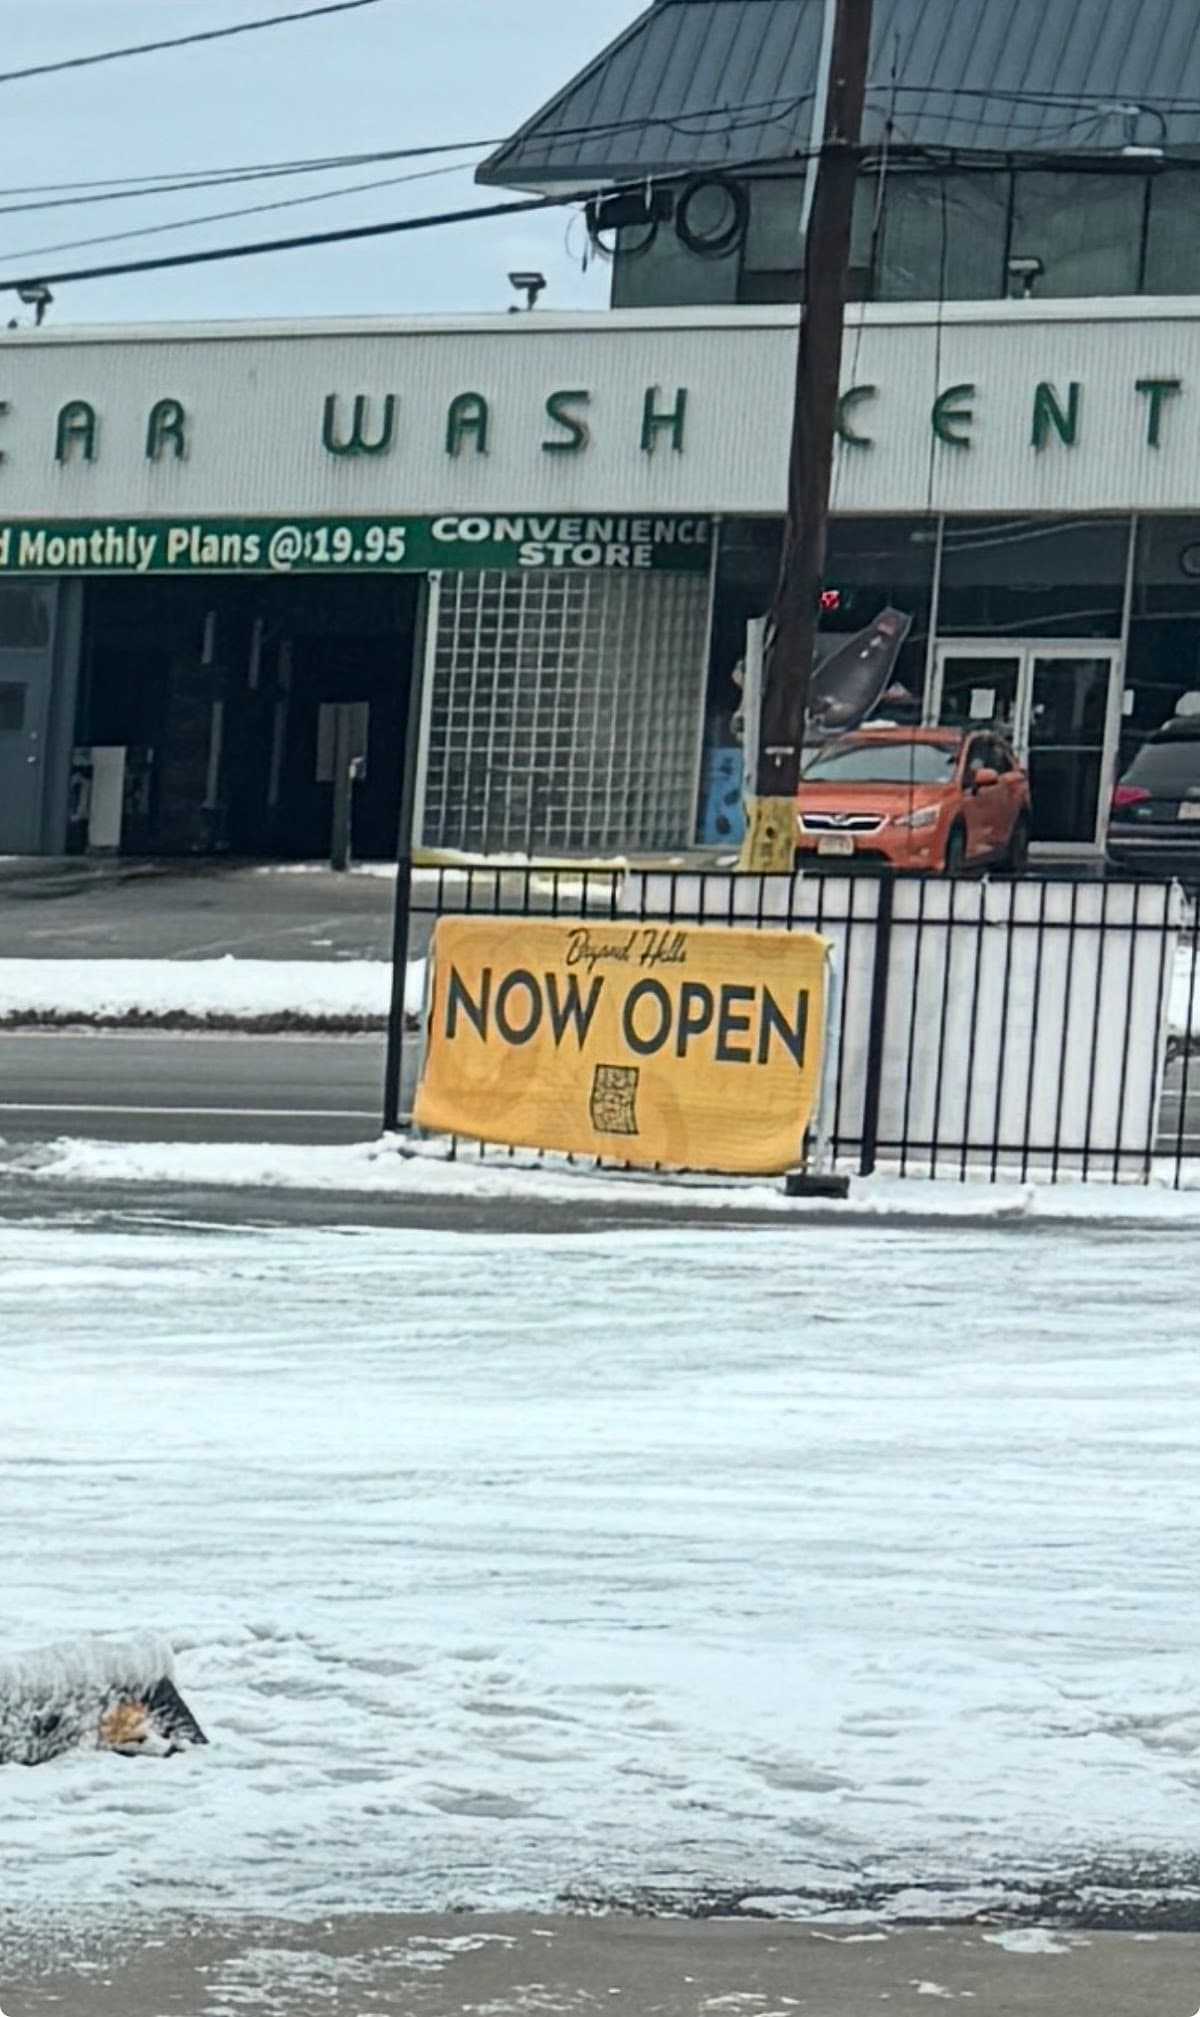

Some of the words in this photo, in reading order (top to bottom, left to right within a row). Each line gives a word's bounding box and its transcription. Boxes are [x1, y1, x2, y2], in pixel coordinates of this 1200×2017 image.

[0, 399, 187, 461] AR
[322, 387, 688, 455] WASH
[837, 380, 1181, 448] CENT
[19, 526, 157, 572] Monthly
[168, 525, 260, 564] Plans
[431, 517, 708, 543] CONVENIENCE
[518, 541, 653, 567] STORE
[445, 965, 604, 1052] NOW
[621, 977, 809, 1068] OPEN
